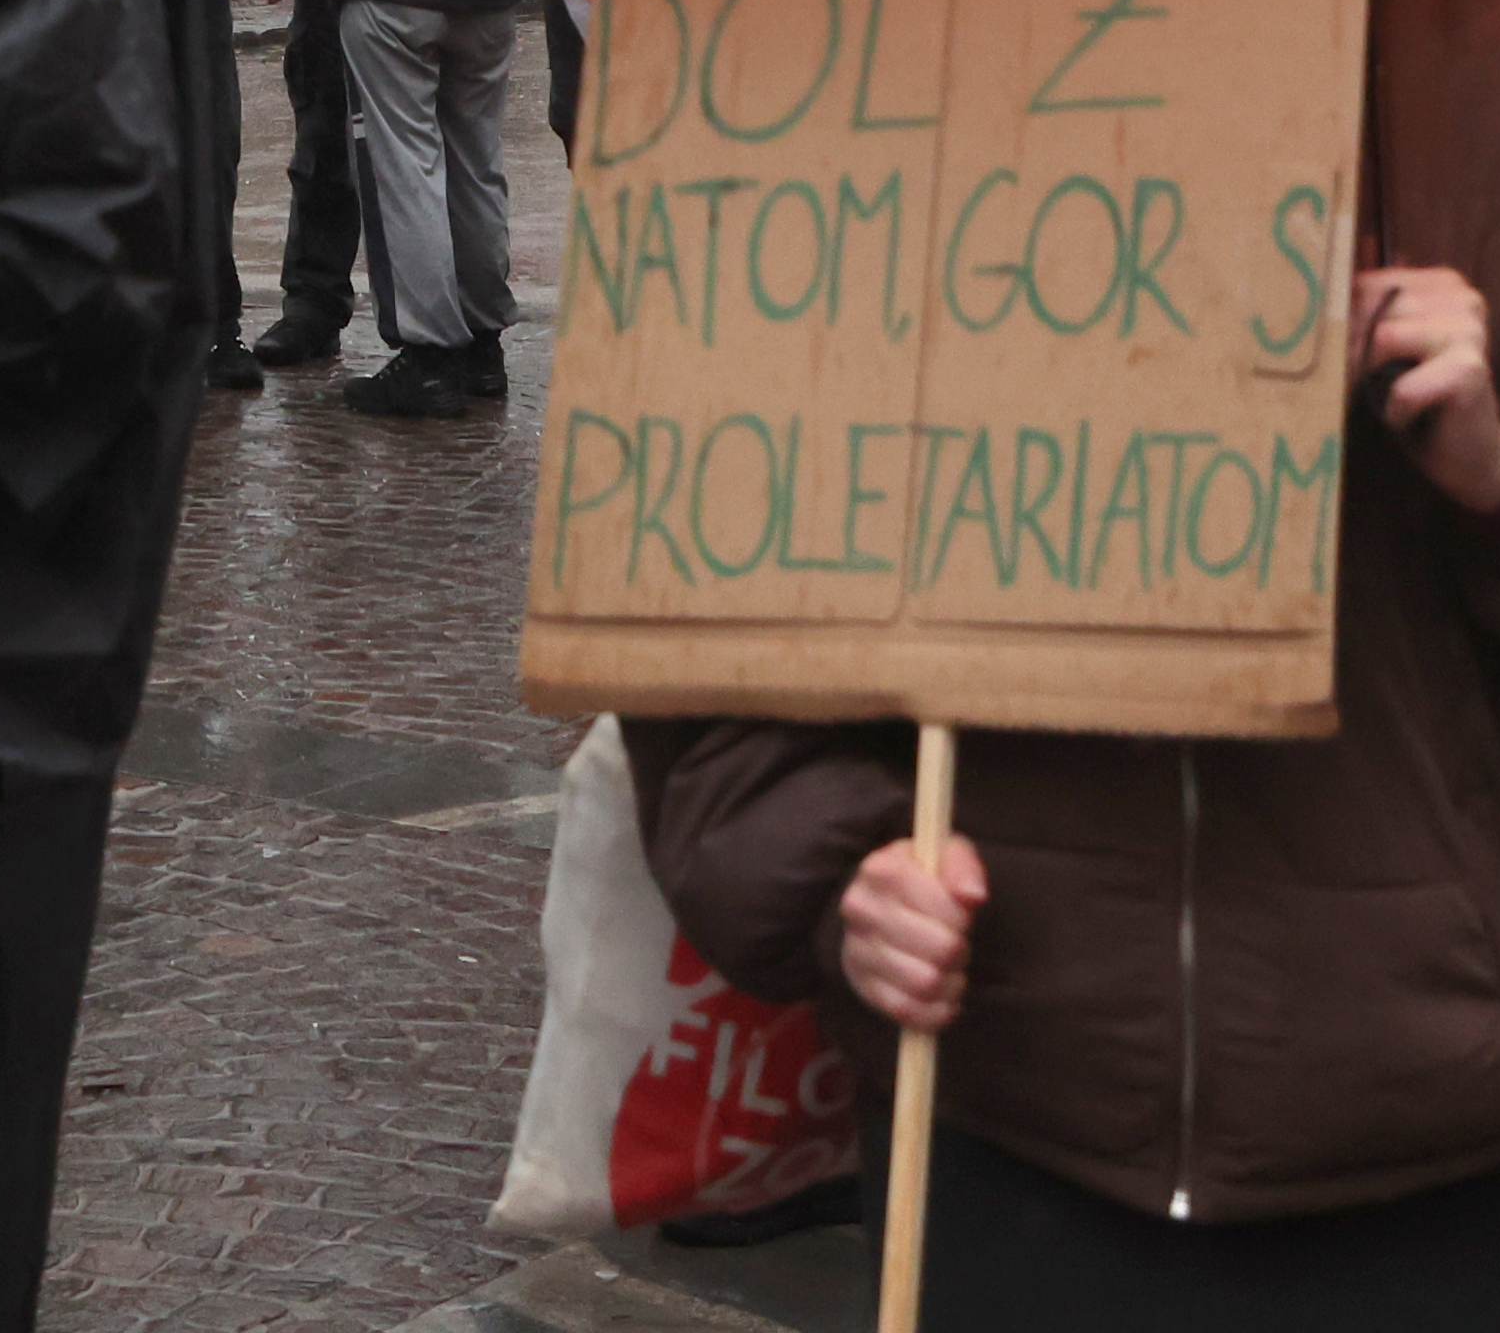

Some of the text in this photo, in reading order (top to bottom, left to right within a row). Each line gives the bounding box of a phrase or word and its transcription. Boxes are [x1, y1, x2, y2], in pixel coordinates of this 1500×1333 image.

[943, 167, 1194, 339] GOR
[1250, 184, 1326, 355] S
[552, 410, 1340, 593] PROLETARIATOM
